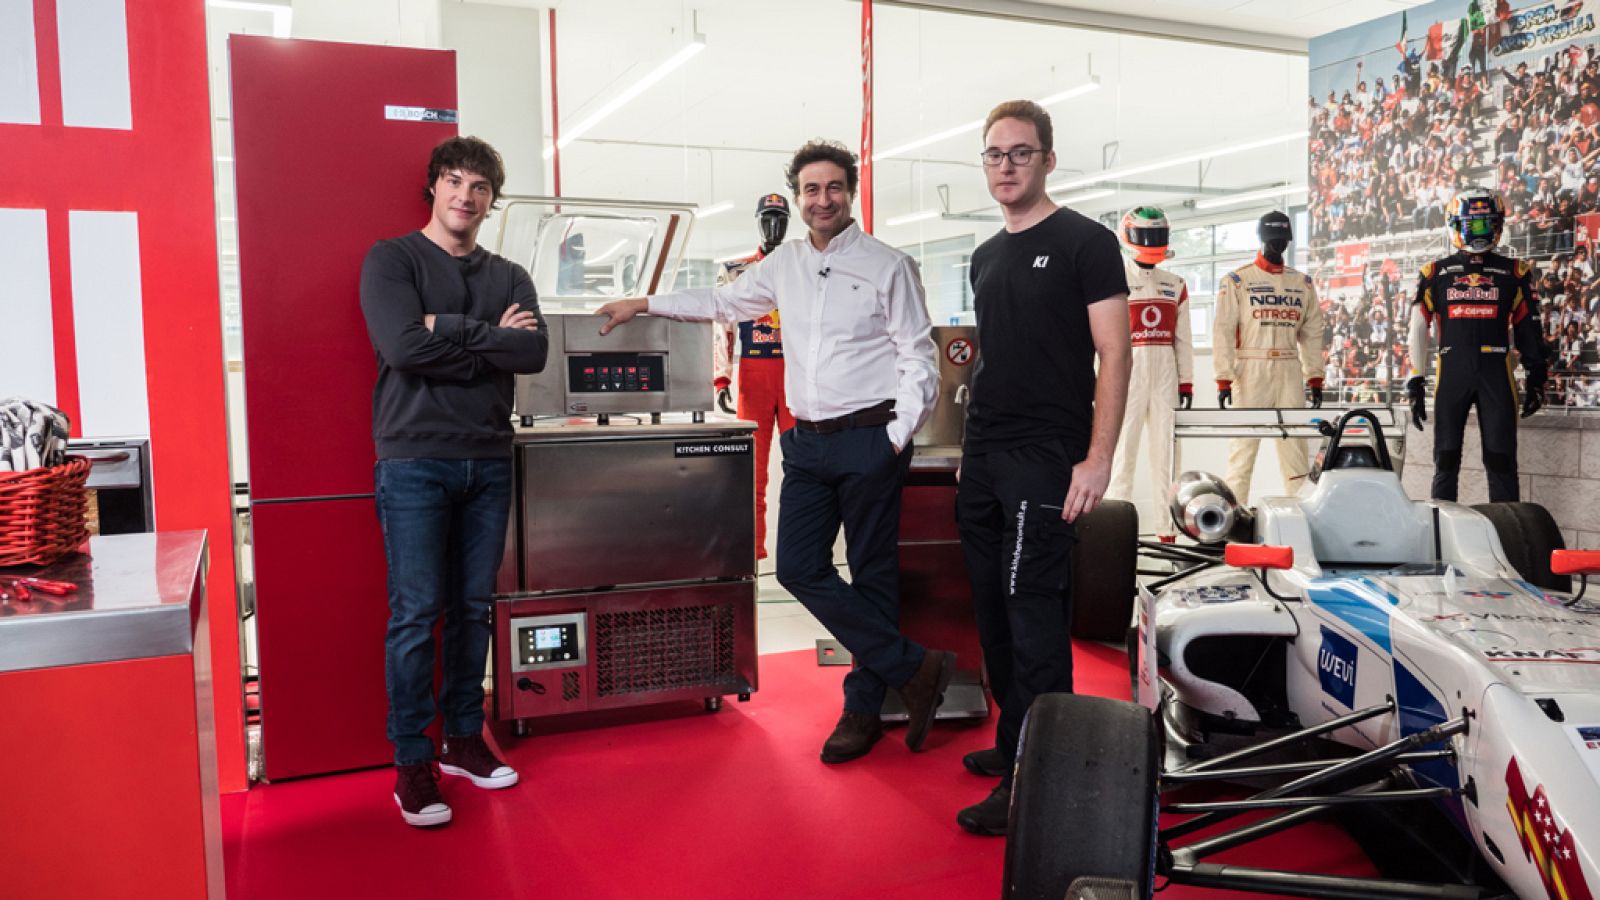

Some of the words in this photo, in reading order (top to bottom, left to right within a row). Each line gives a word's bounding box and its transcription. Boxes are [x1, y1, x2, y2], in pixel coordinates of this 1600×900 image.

[1032, 255, 1050, 268] KI
[1446, 287, 1473, 301] Red
[1473, 287, 1499, 301] Bull
[1250, 295, 1302, 308] NOKIA
[676, 446, 711, 454] KITCHEN
[713, 444, 748, 453] CONSULT
[1009, 500, 1028, 596] www.kitchenconsult.es
